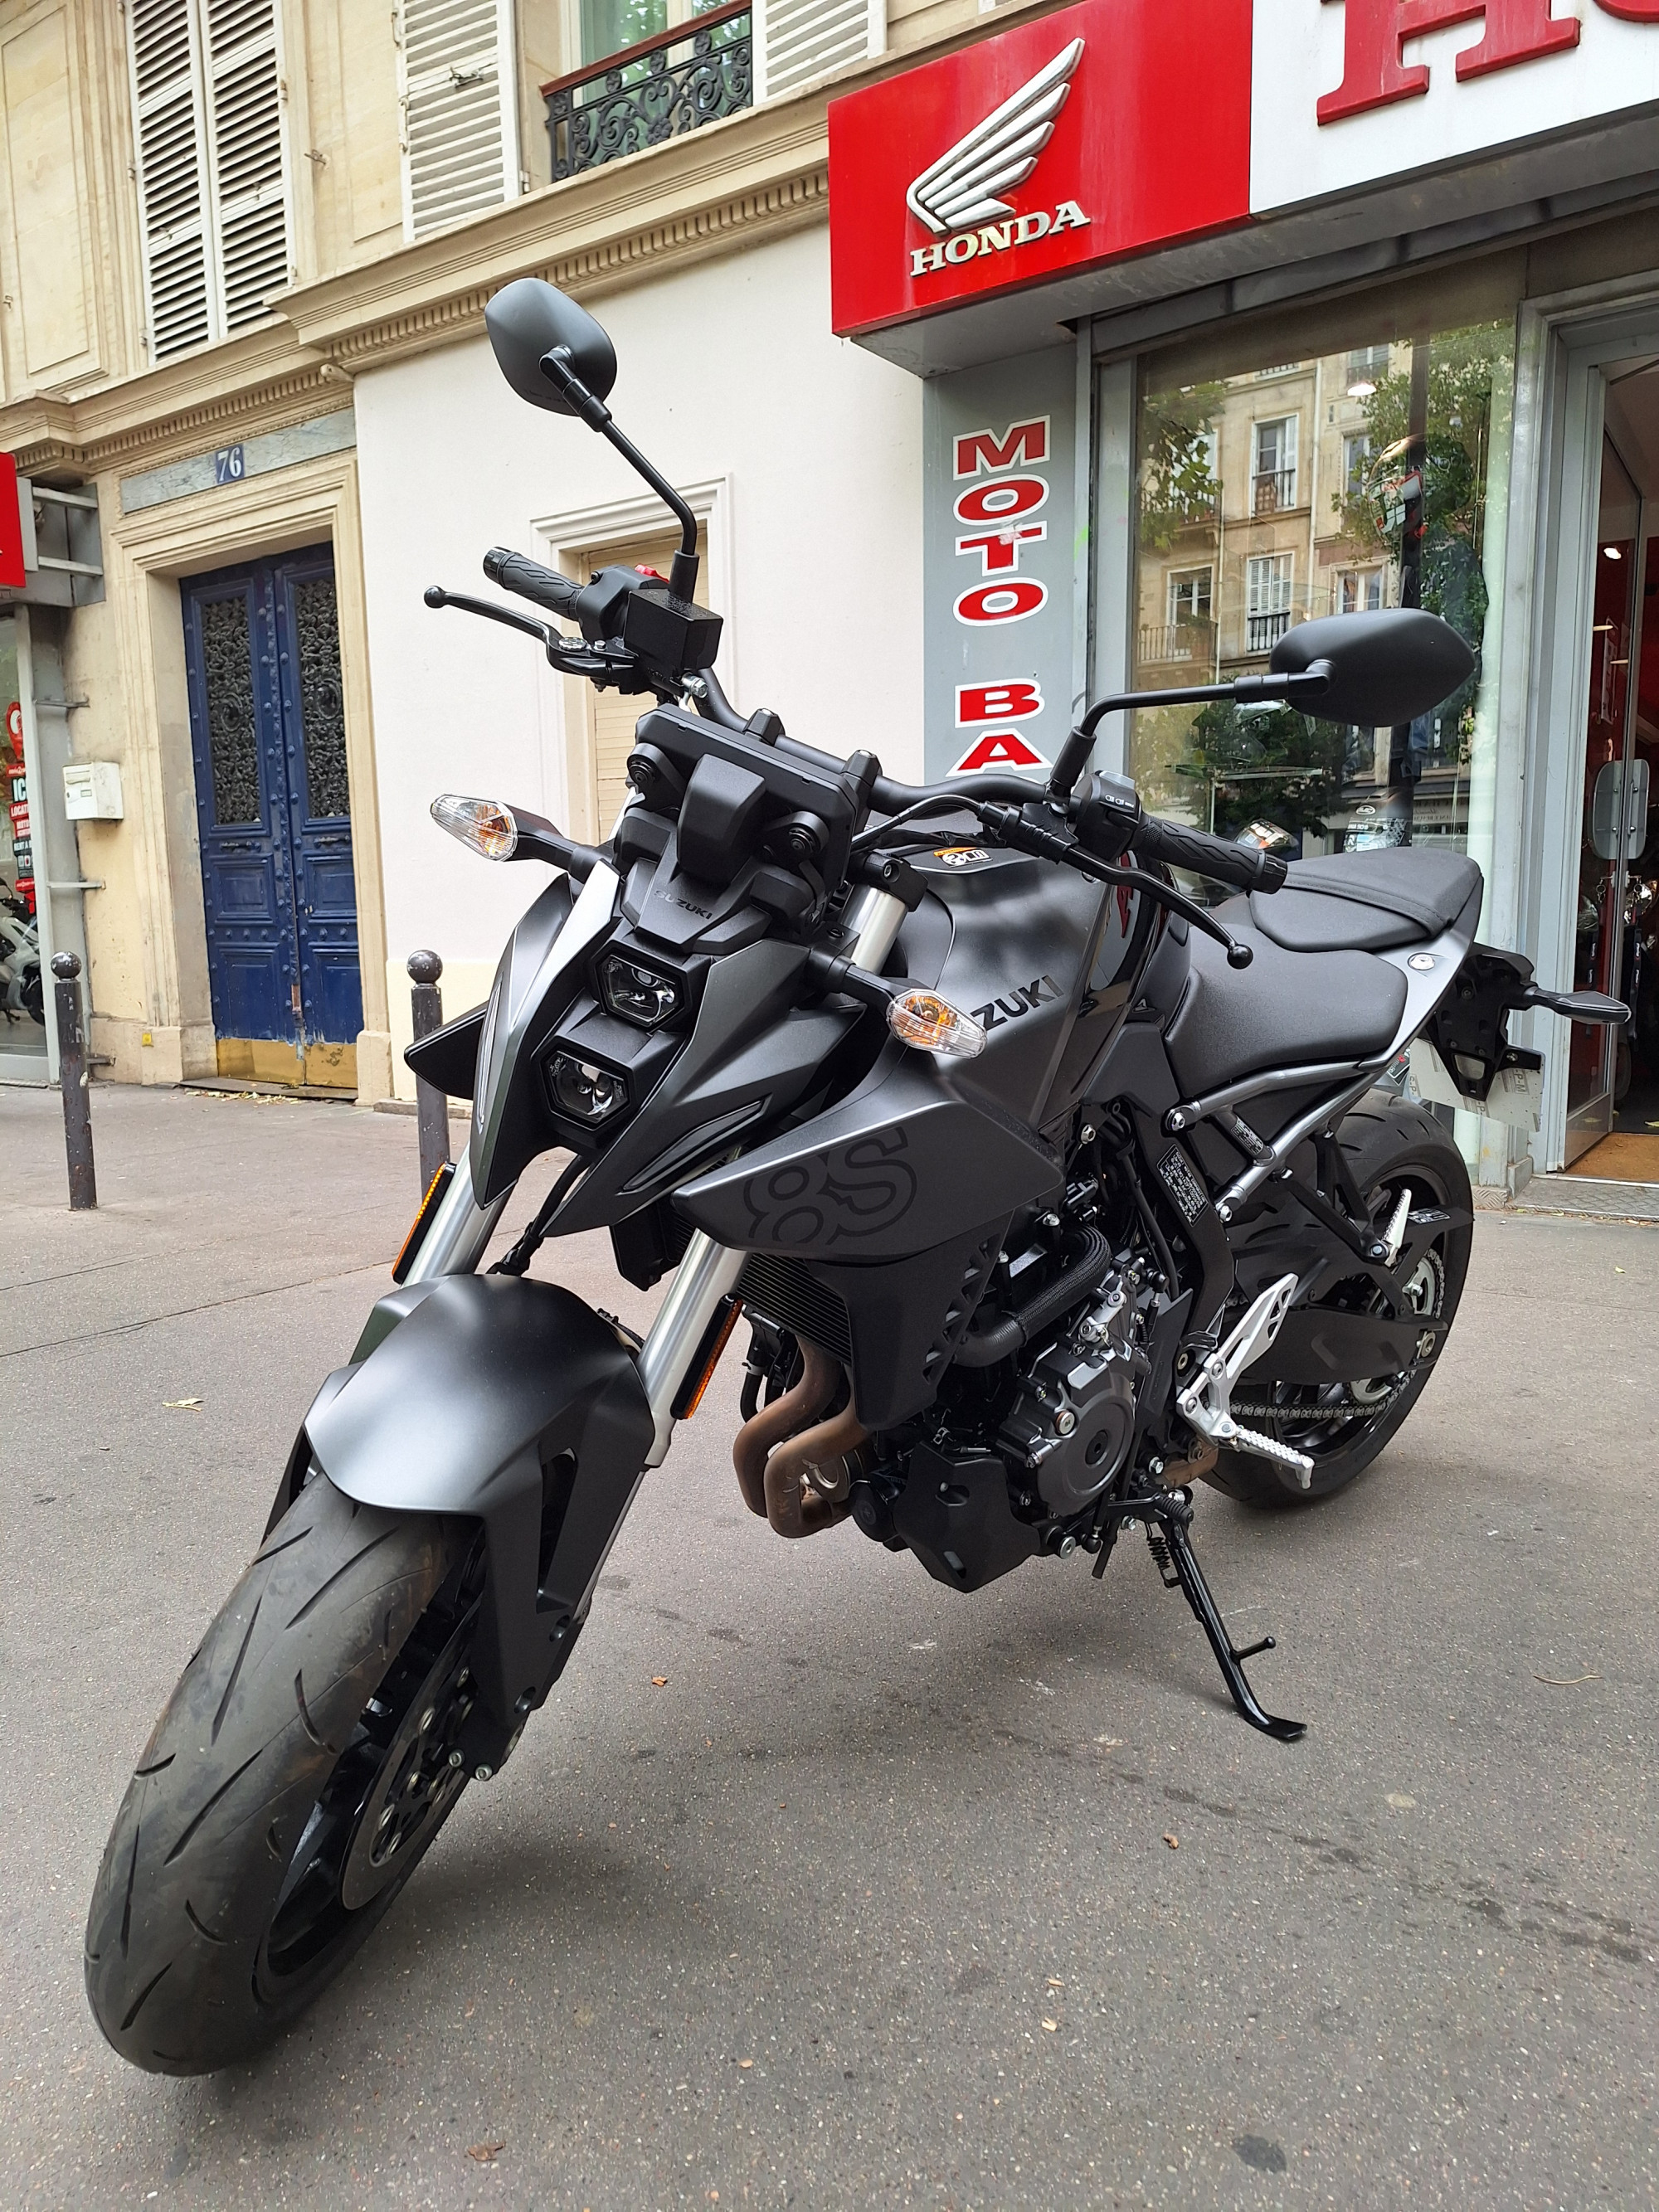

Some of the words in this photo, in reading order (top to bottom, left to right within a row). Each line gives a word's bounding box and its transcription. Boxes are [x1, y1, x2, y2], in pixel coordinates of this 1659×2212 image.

[910, 200, 1091, 276] HONDA
[217, 447, 241, 481] 76
[953, 415, 1050, 626] MOTO
[946, 678, 1053, 784] BA
[12, 778, 27, 802] IC
[654, 890, 713, 920] SUZUKI
[970, 975, 1064, 1031] ZUKI
[743, 1126, 917, 1245] 8S
